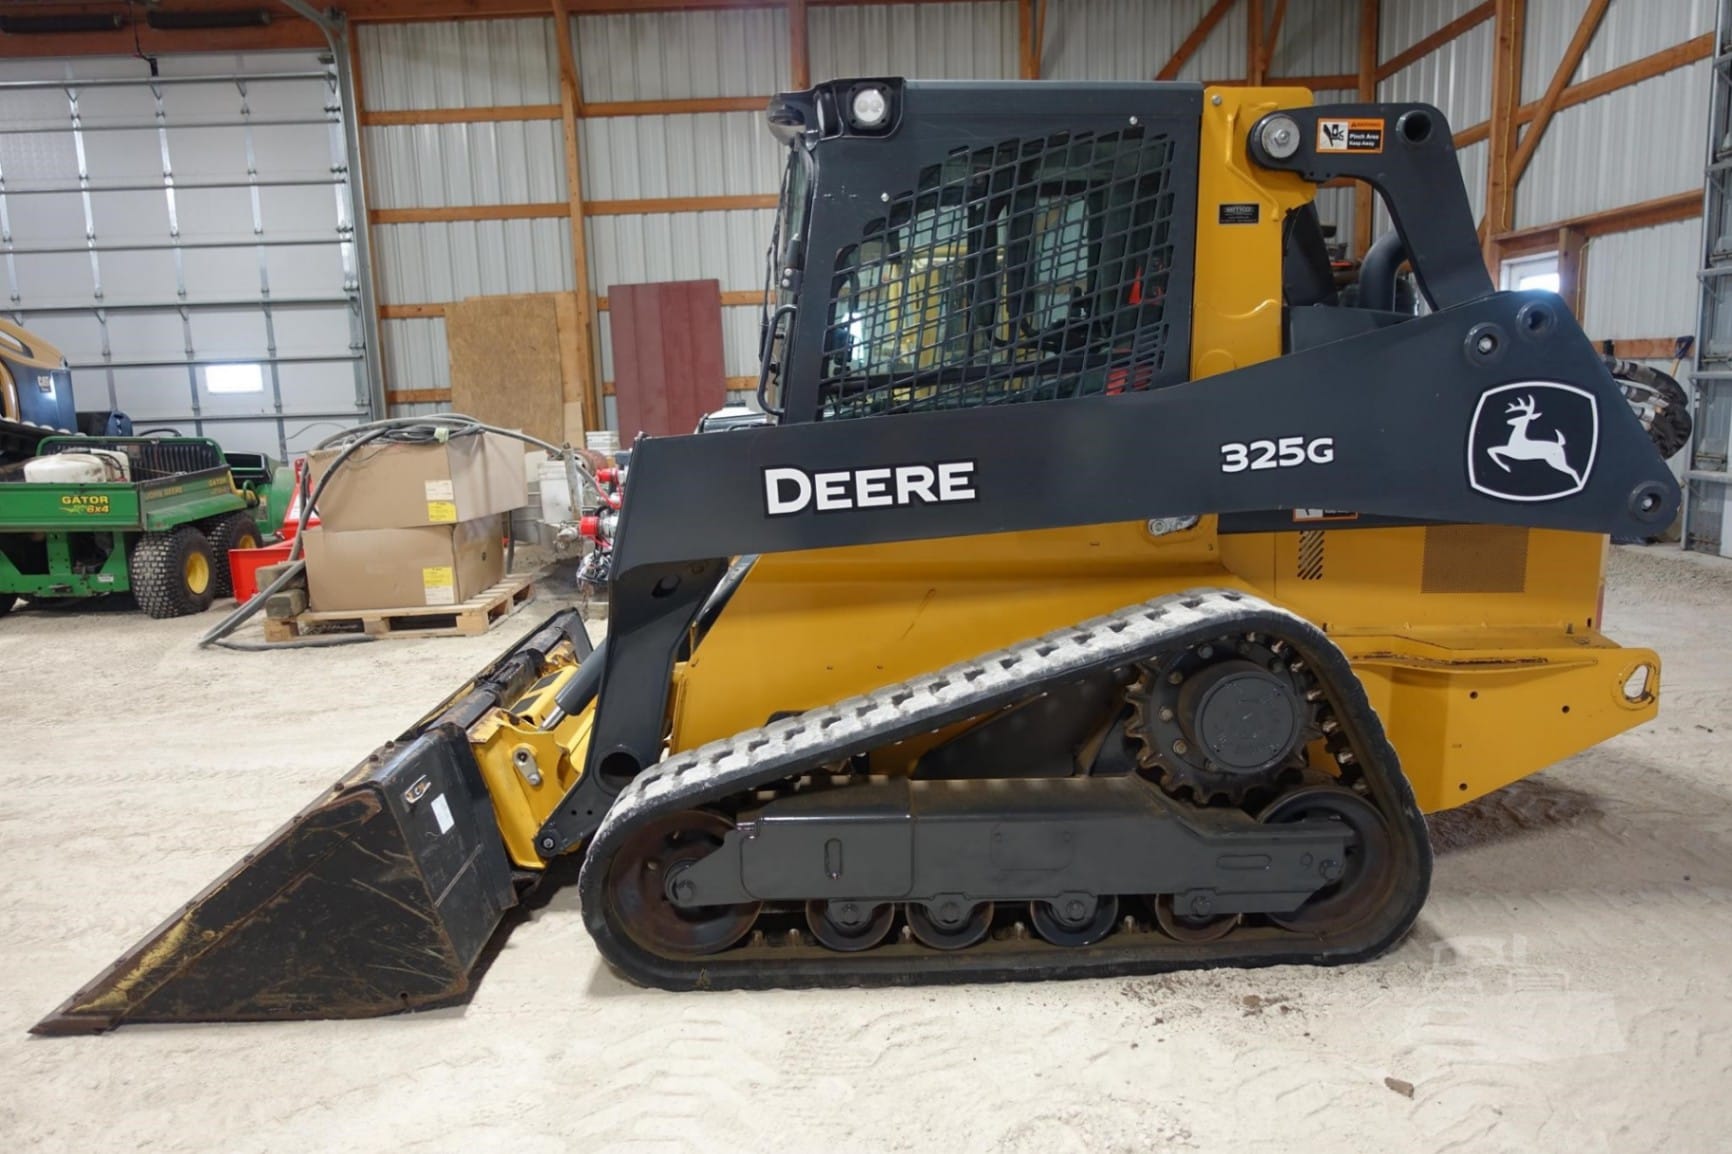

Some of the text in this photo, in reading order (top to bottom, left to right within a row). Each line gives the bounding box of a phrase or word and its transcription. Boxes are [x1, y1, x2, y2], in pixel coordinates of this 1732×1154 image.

[1221, 436, 1334, 473] 325G
[764, 461, 976, 515] DEERE
[62, 495, 108, 505] GATOR
[87, 504, 109, 514] 6x4
